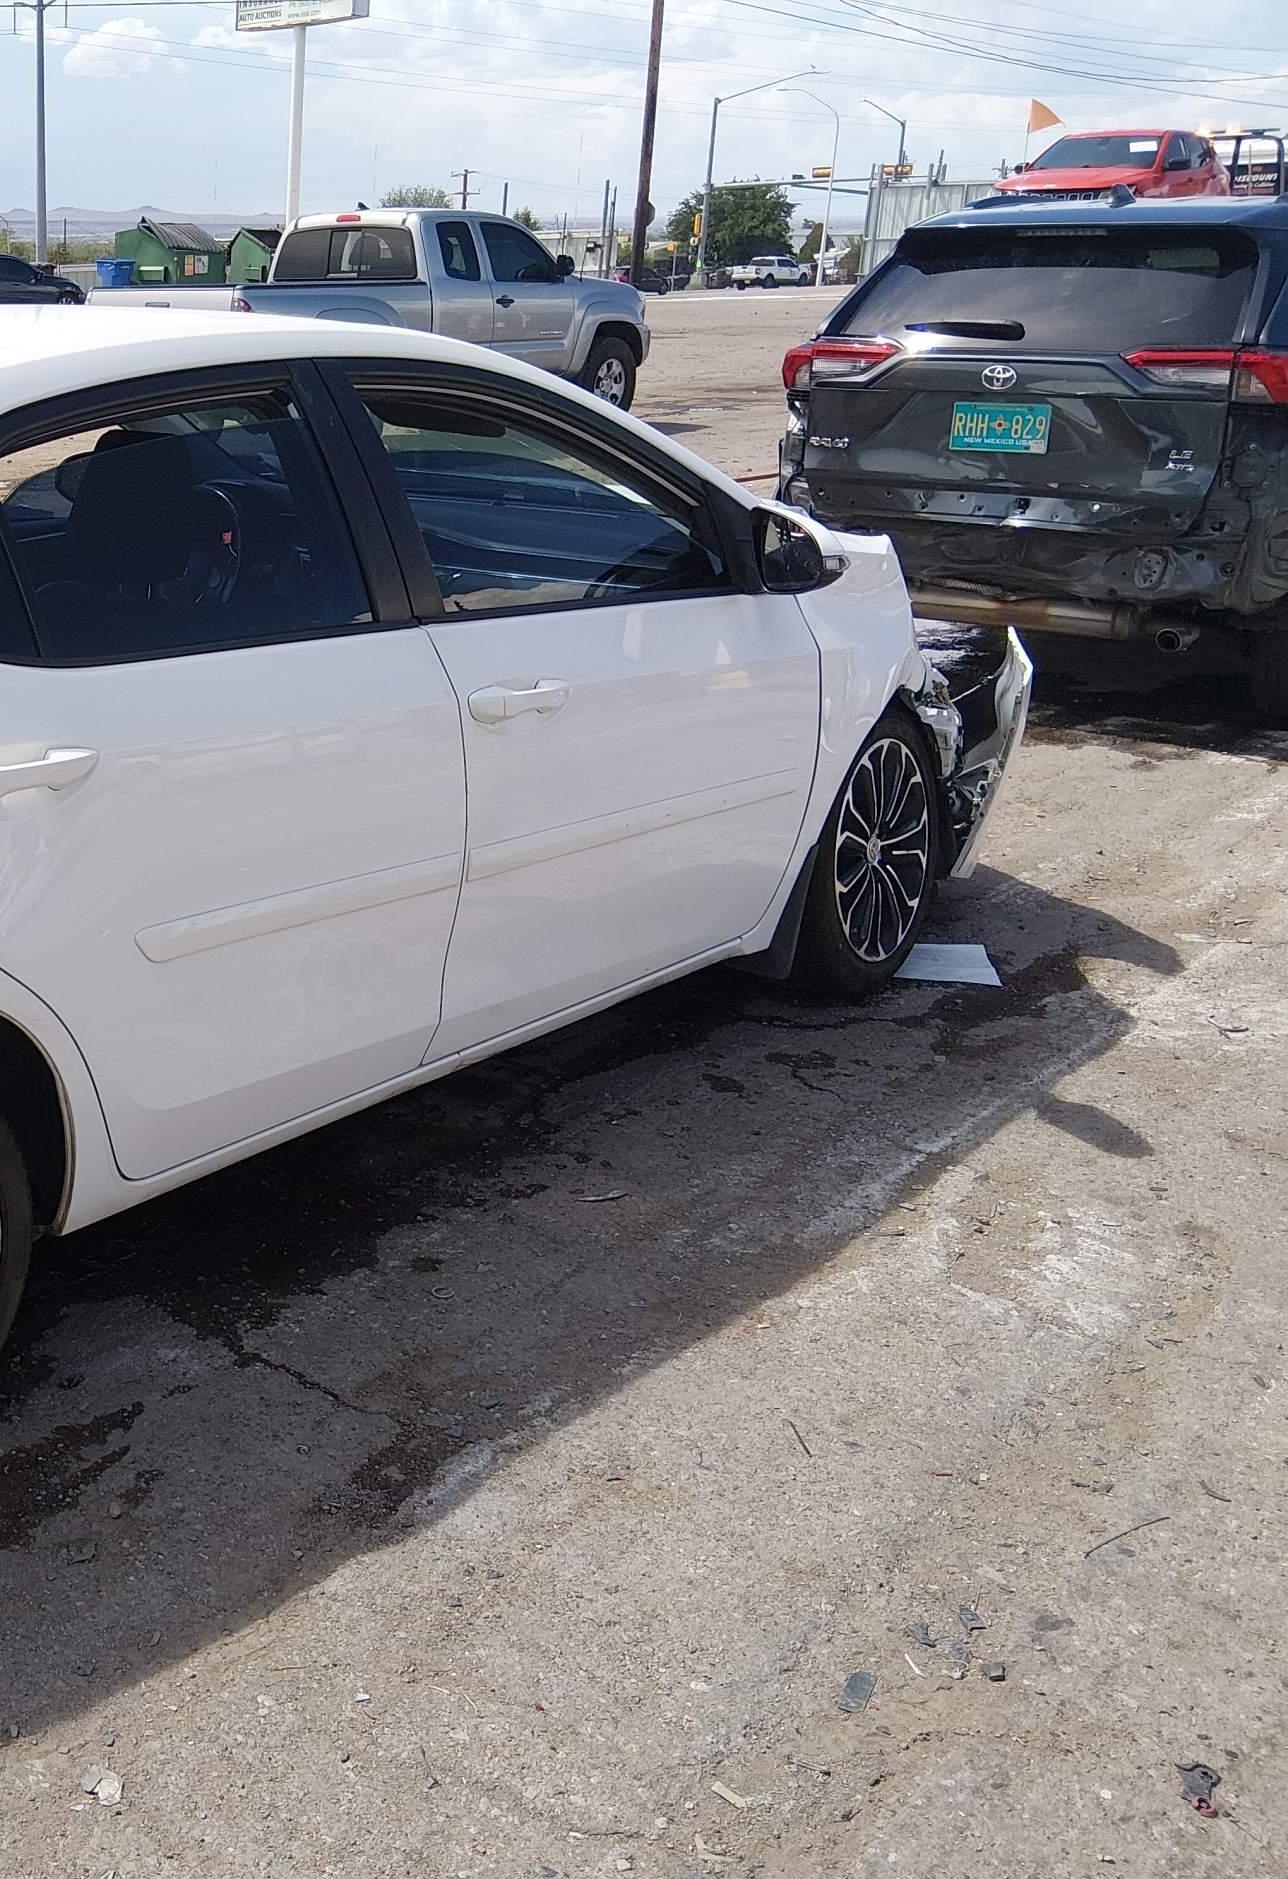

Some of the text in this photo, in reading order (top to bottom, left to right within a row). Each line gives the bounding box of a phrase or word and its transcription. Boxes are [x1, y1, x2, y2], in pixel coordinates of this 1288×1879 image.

[239, 9, 282, 23] AUTO AUCTIONS
[953, 413, 1046, 439] RHH 829
[984, 437, 1014, 445] MEXICO
